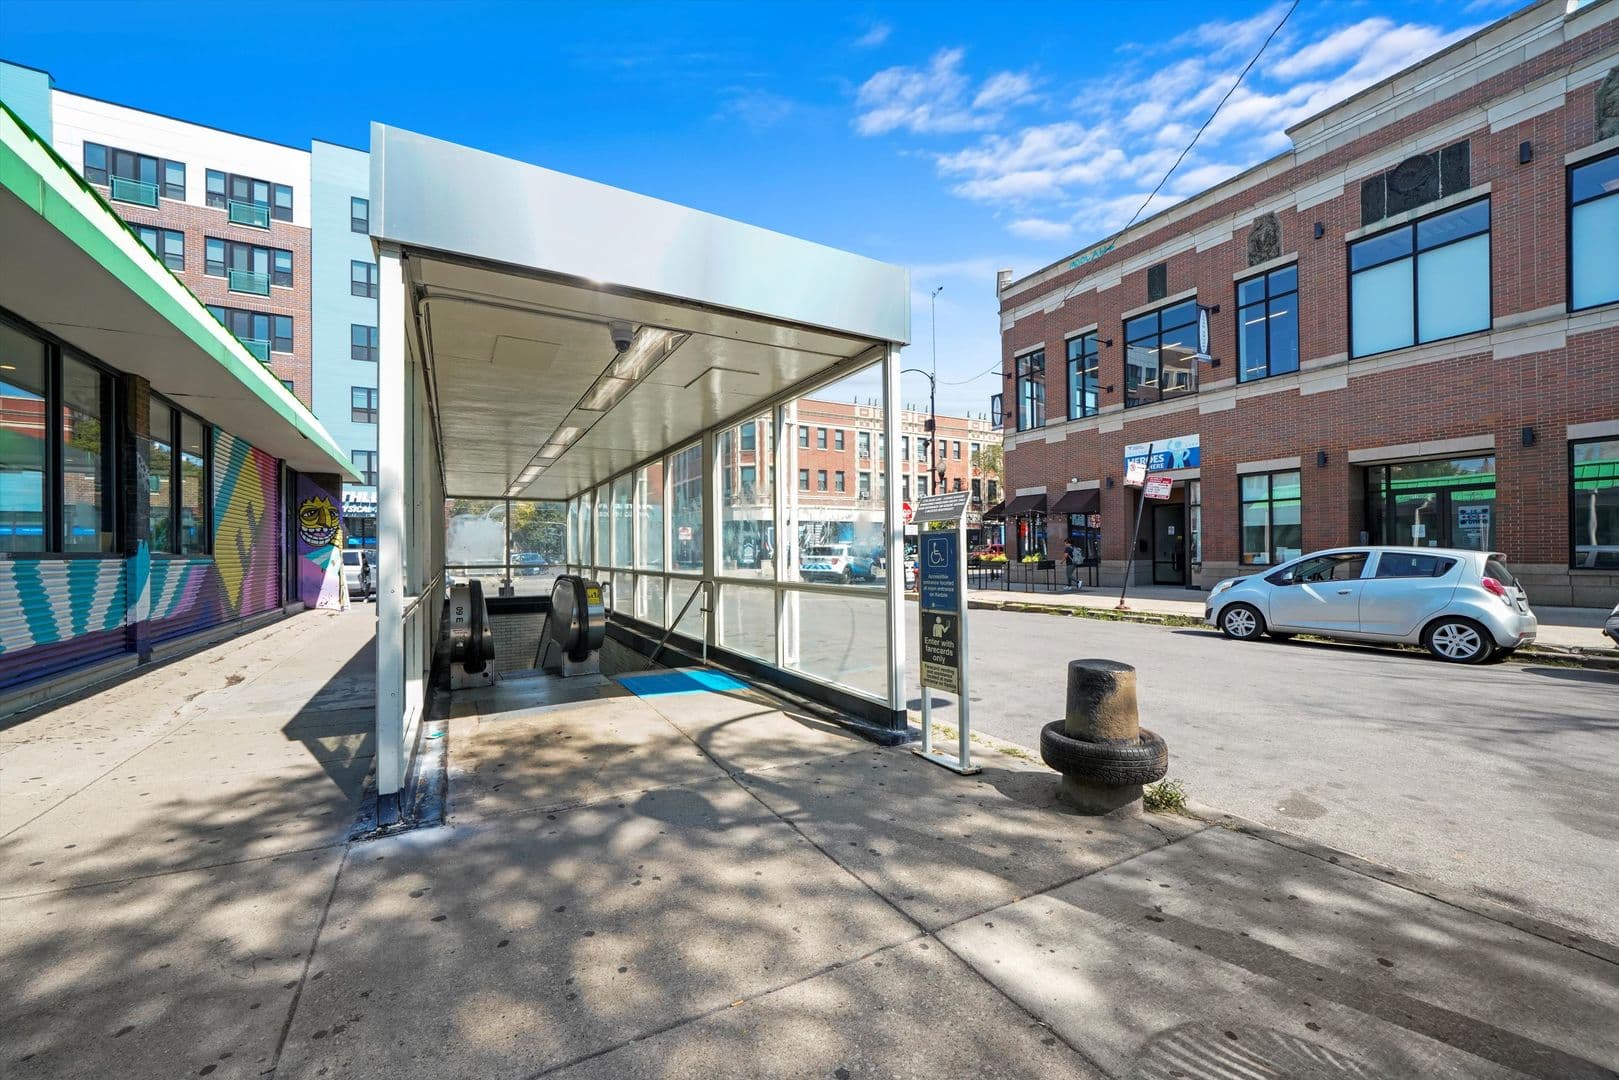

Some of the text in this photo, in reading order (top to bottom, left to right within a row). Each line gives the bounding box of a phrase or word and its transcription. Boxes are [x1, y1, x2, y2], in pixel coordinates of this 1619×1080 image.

[924, 636, 955, 648] Enter with
[925, 645, 954, 656] farecards
[932, 655, 946, 665] only
